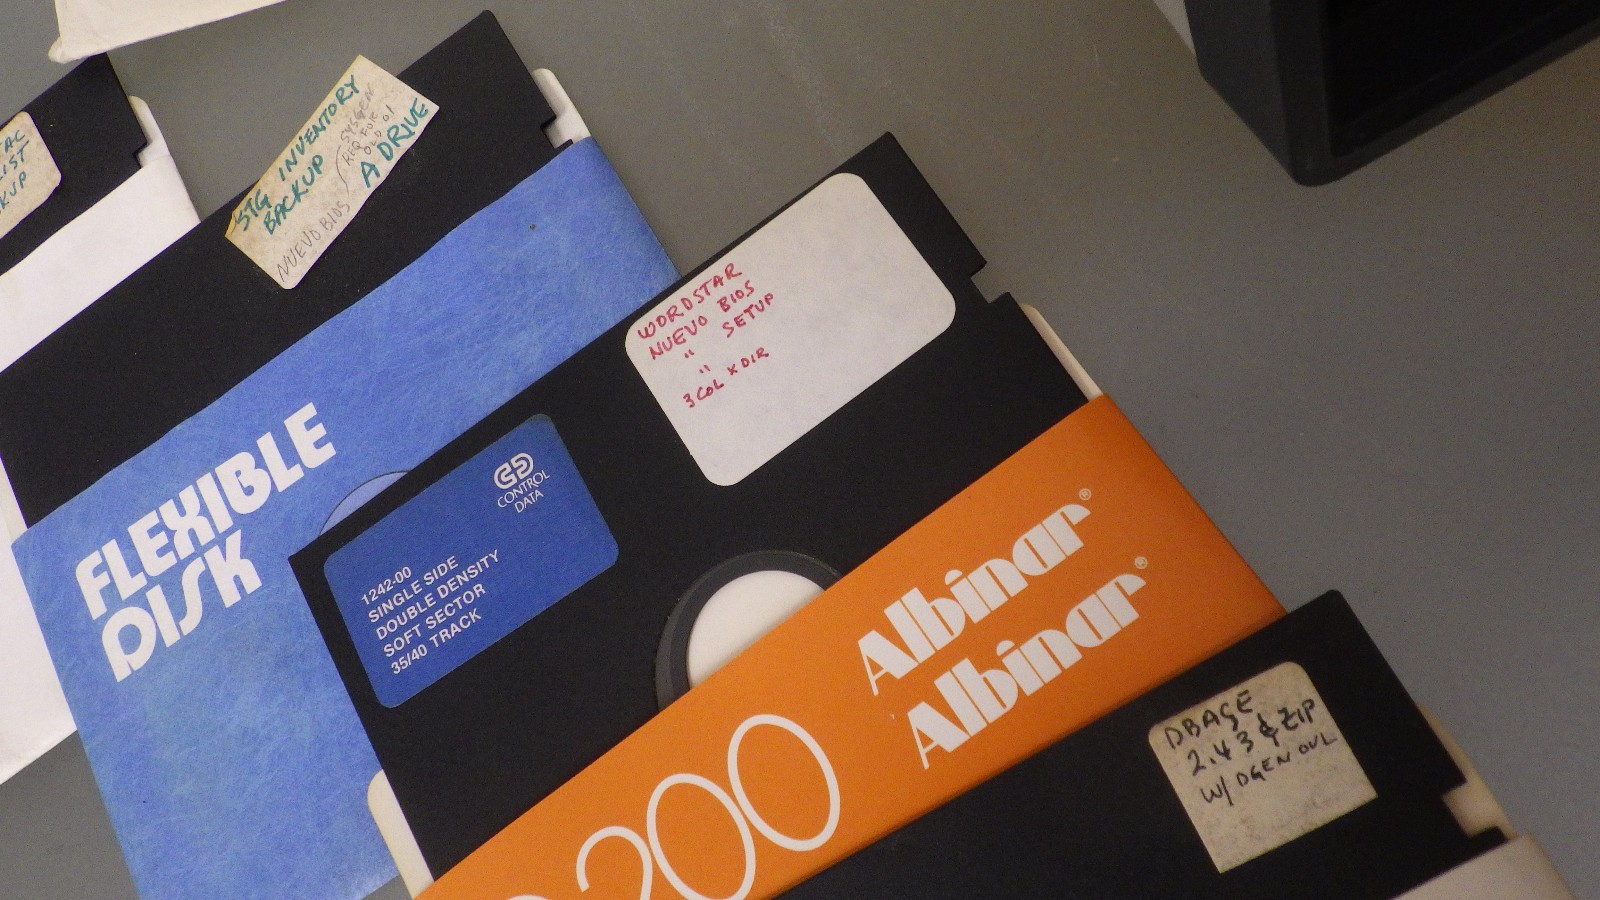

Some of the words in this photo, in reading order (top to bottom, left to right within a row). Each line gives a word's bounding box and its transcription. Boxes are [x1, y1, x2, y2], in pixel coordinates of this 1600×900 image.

[0, 130, 25, 153] AC
[0, 140, 29, 181] IST
[279, 75, 360, 181] INVENTORY
[360, 161, 380, 188] A
[377, 98, 428, 161] DRIVE
[0, 171, 26, 214] KUP
[264, 154, 323, 235] BACKUP
[277, 230, 321, 282] NUEVO
[637, 263, 742, 340] WORDSTAR
[649, 316, 708, 360] NUEVO
[717, 280, 755, 312] BIOS
[722, 293, 774, 338] SETUP
[75, 401, 337, 621] FLEXIBLE
[497, 470, 550, 508] CONTROL
[514, 489, 544, 513] DATA
[101, 529, 262, 683] DISK
[361, 566, 412, 606] 1242-00
[368, 580, 422, 623] SINGLE
[422, 556, 459, 586] SIDE
[375, 593, 436, 640] DOUBLE
[436, 549, 500, 598] DENSITY
[383, 624, 423, 658] SOFT
[424, 583, 486, 630] SECTOR
[391, 644, 428, 675] 35/40
[429, 608, 482, 648] TRACK
[1278, 699, 1315, 732] ZIP
[505, 714, 841, 900] 200
